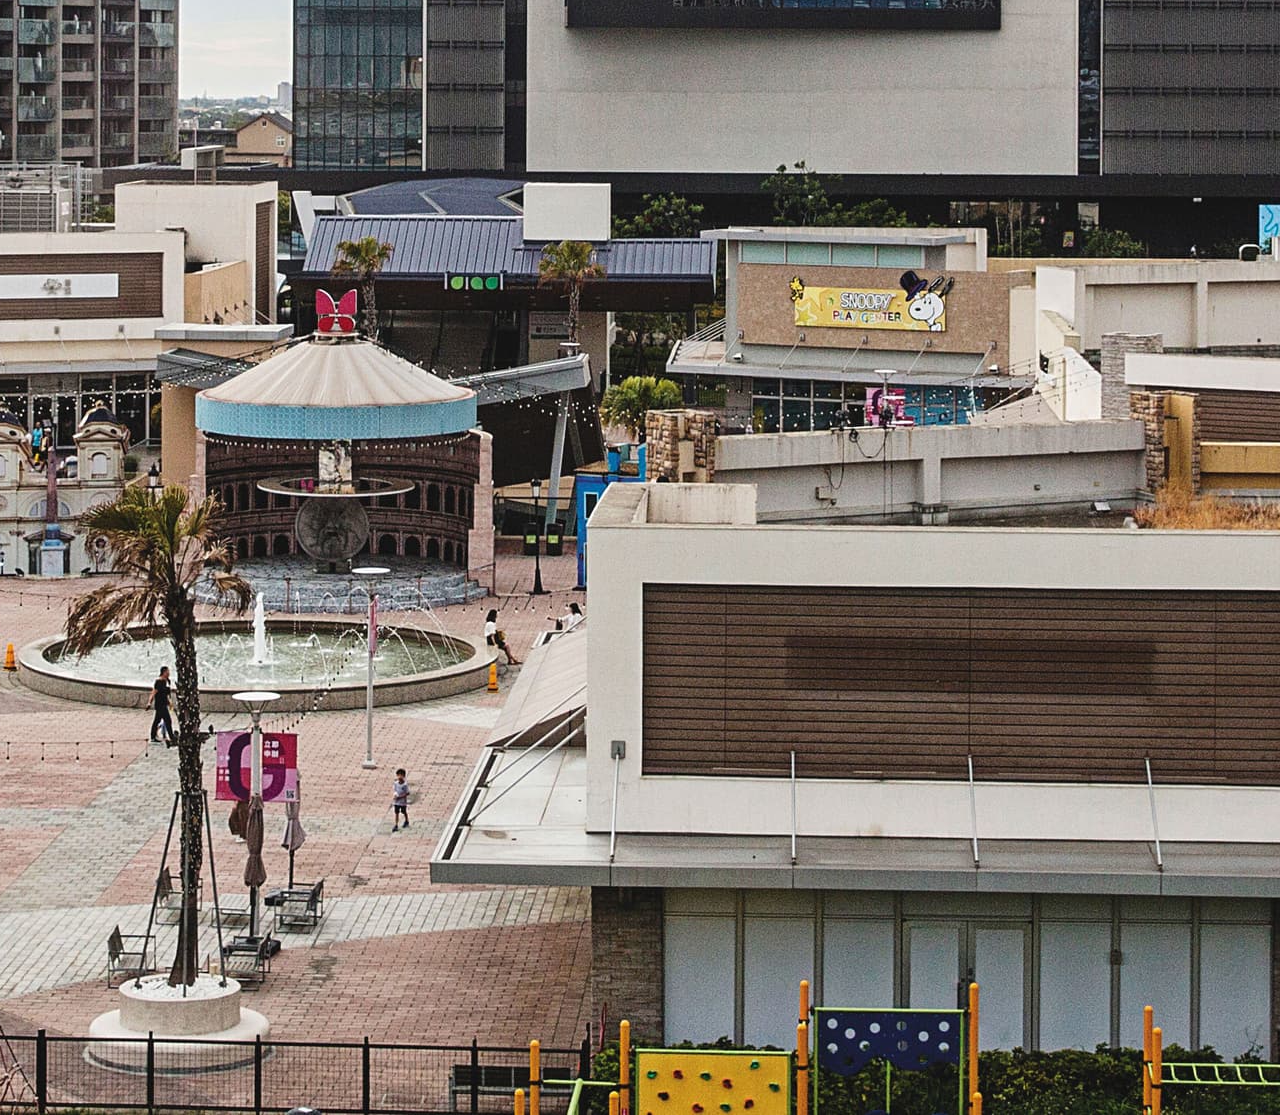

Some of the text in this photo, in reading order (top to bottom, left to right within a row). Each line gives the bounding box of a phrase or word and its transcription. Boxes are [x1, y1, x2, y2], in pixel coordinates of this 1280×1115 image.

[840, 292, 891, 310] SNOOPY
[833, 310, 901, 323] PLAY CENTER
